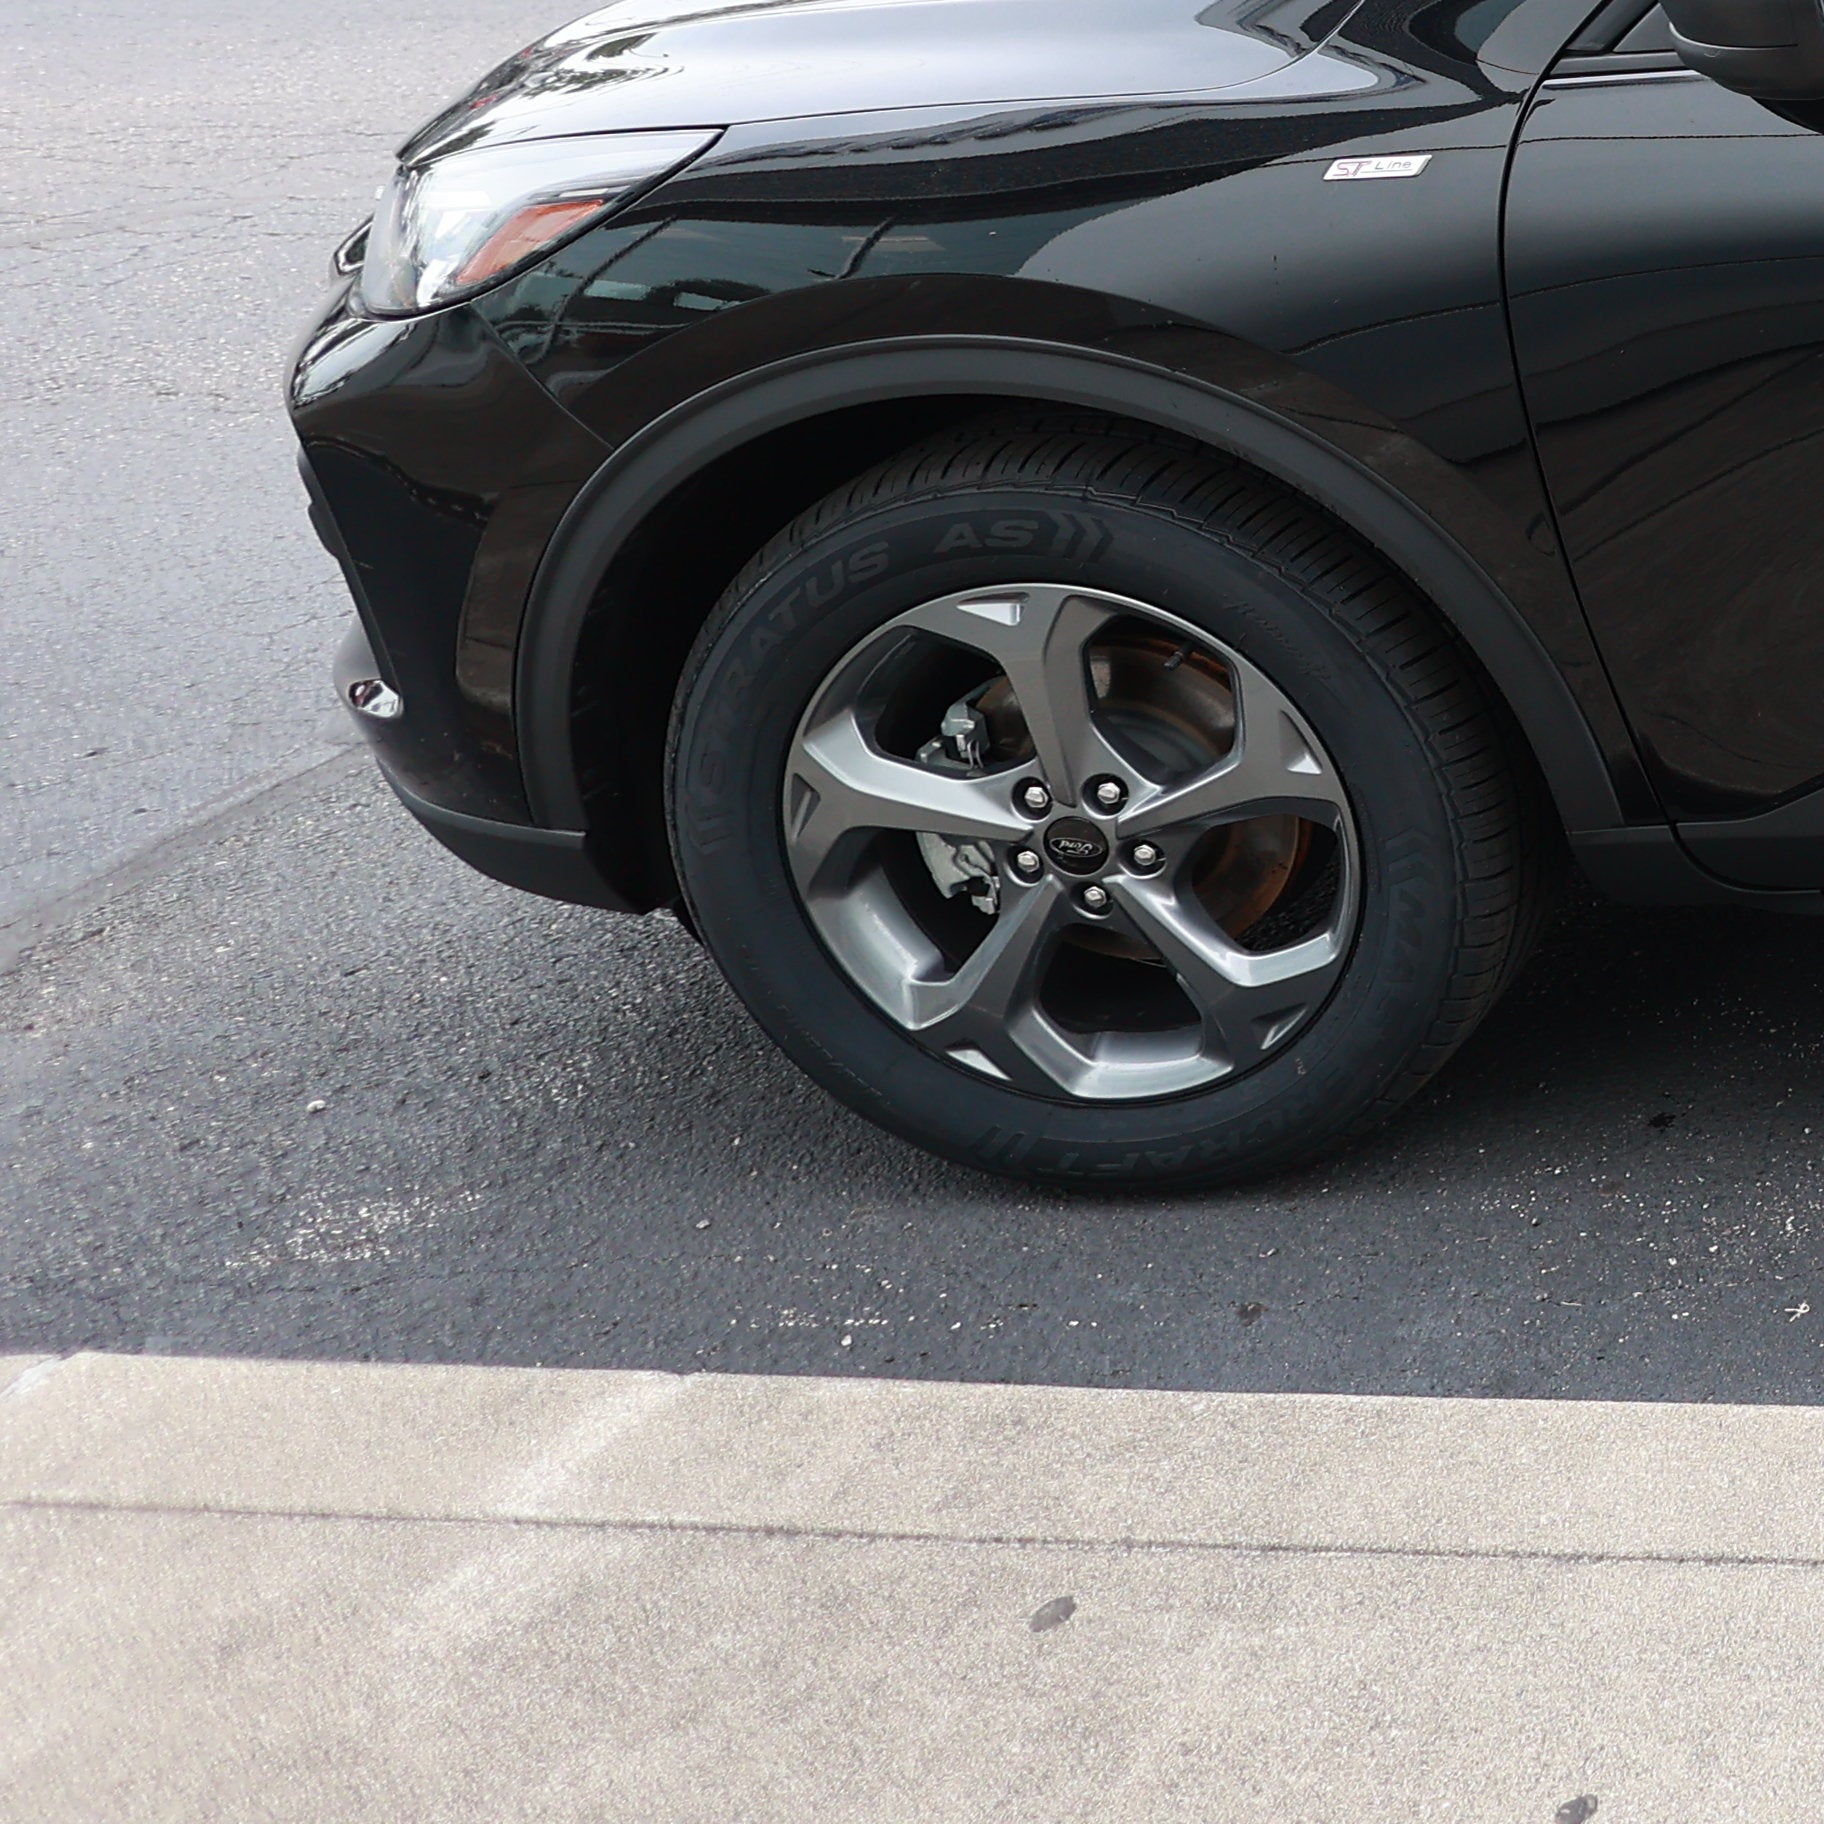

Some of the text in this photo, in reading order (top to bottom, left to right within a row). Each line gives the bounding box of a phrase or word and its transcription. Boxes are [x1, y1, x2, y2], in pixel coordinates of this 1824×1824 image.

[1332, 160, 1412, 177] ST Line
[932, 519, 1040, 554] AS
[1058, 839, 1093, 855] Ford
